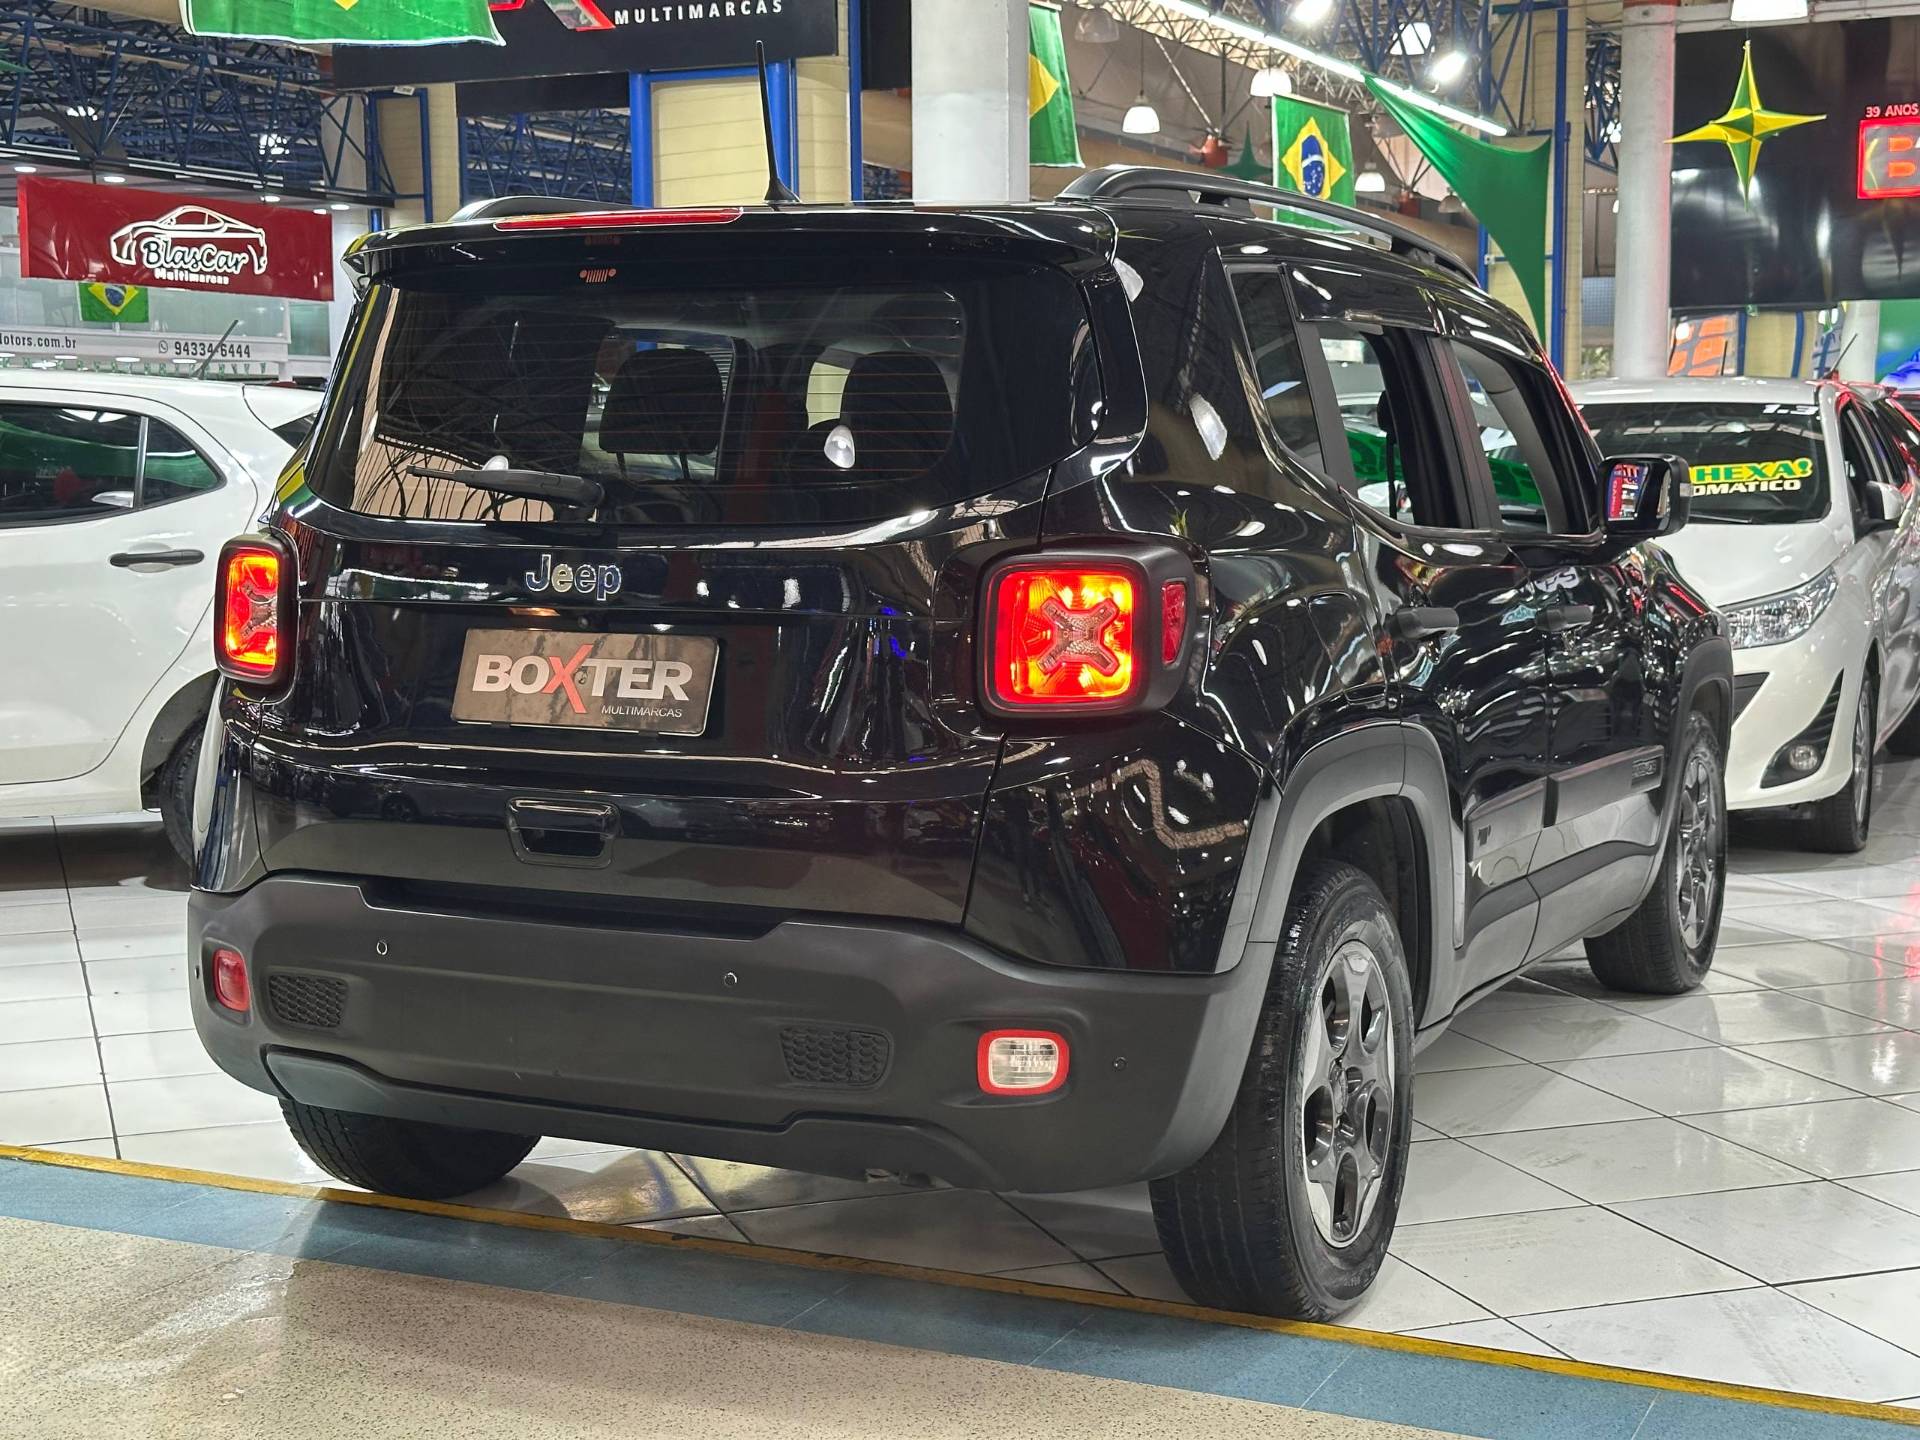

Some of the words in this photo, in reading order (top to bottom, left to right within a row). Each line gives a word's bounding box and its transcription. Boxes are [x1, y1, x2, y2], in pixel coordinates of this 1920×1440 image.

[614, 0, 783, 26] MULTIMARCAS
[1865, 106, 1881, 118] 39
[1884, 103, 1919, 117] ANOS
[140, 236, 249, 275] BlasCar
[155, 267, 230, 285] Multimarcas
[1762, 403, 1819, 416] 1.3
[1693, 458, 1812, 483] HEXA!
[525, 553, 622, 601] Jeep
[472, 644, 693, 714] BOXTER
[601, 704, 683, 718] MULTIMARCAS
